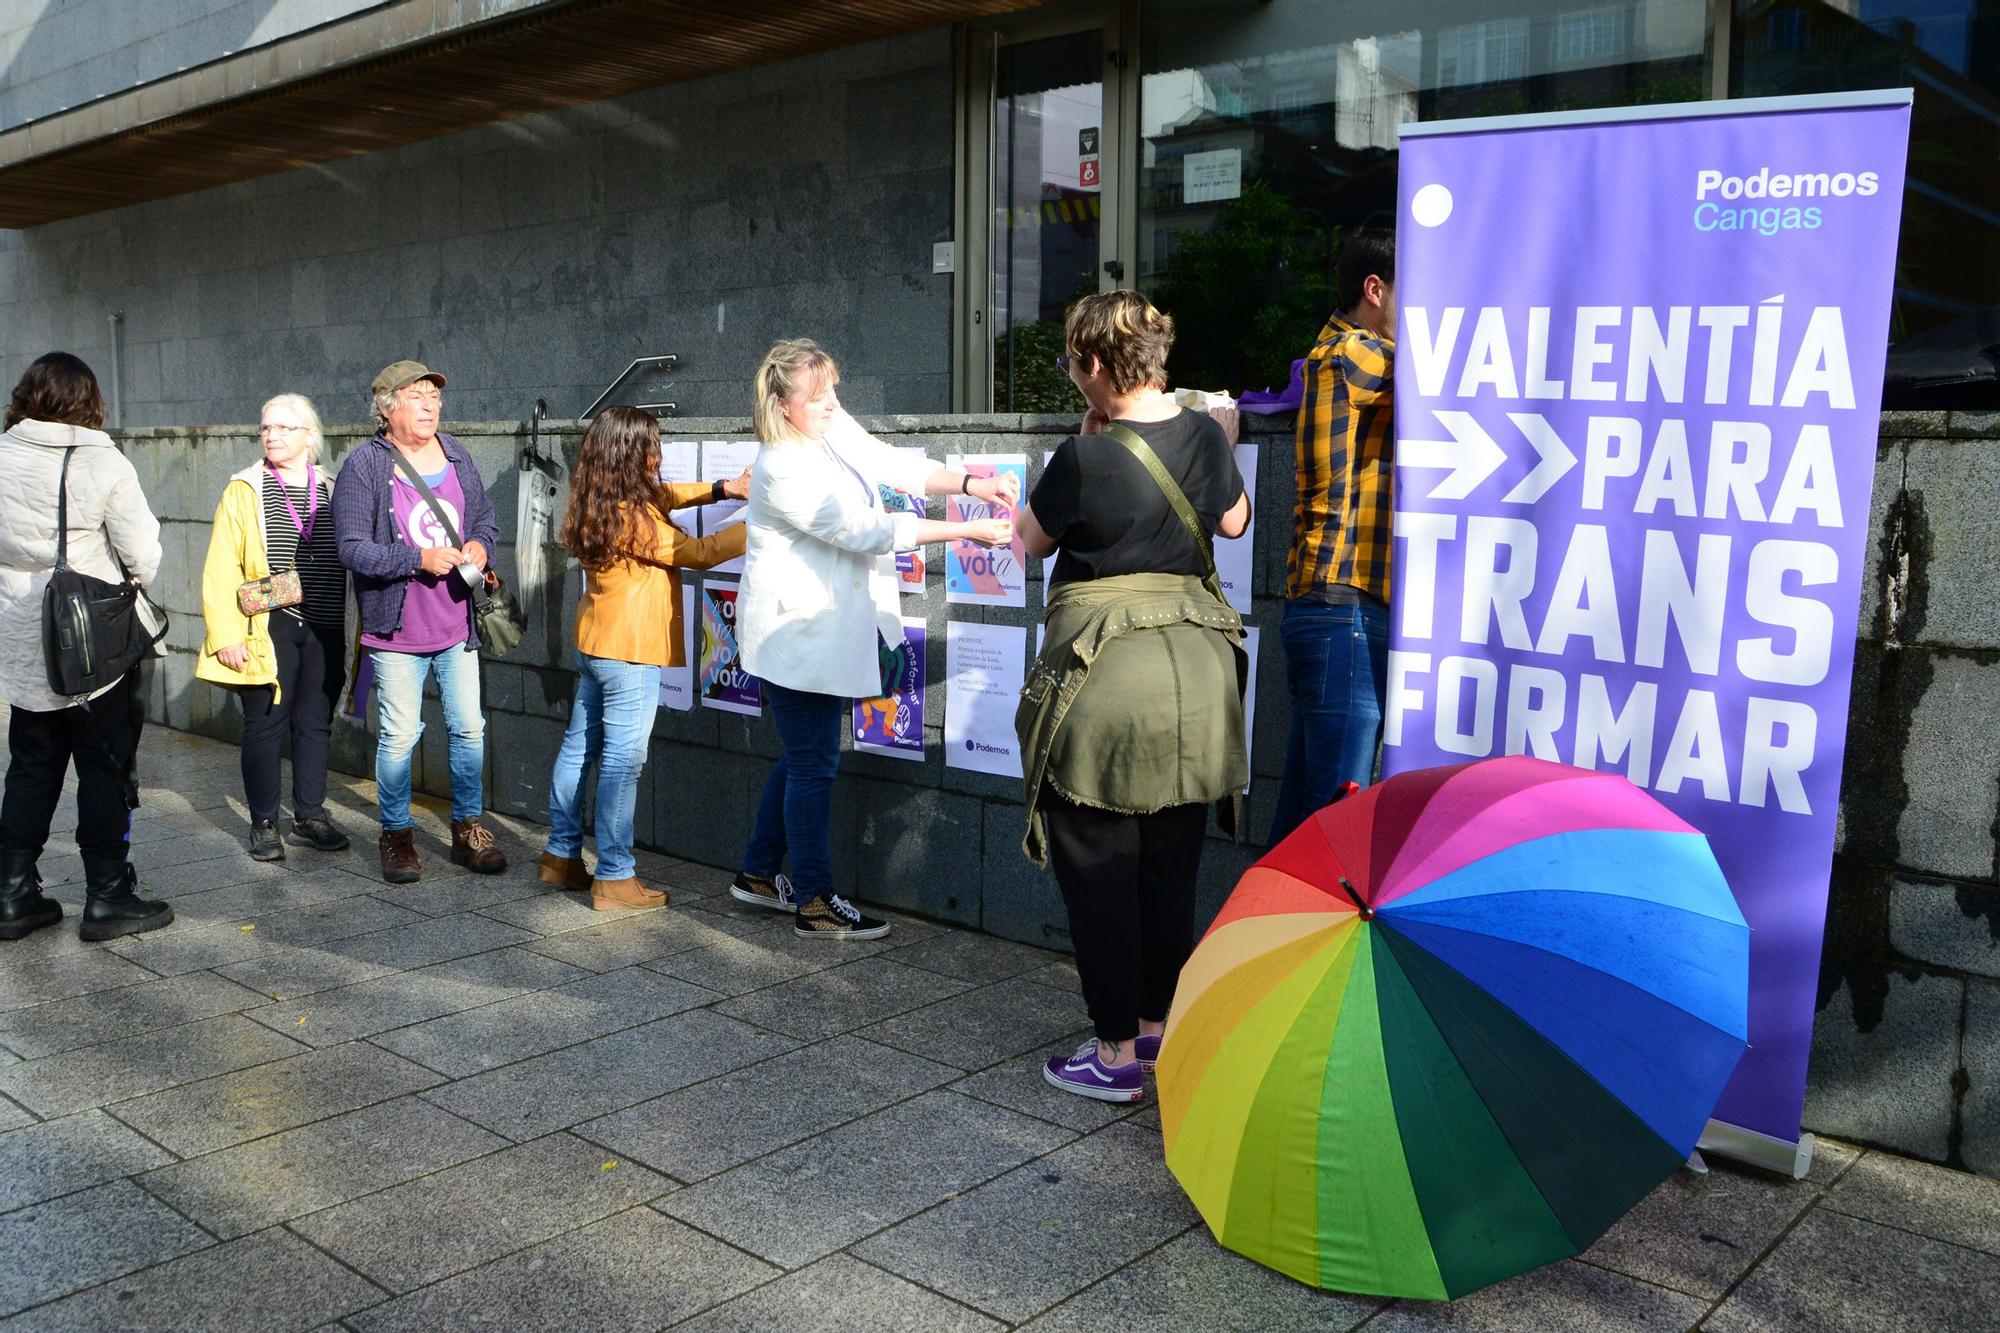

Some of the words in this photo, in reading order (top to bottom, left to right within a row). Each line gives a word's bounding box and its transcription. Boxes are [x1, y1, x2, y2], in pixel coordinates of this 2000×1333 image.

[1696, 167, 1879, 200] Podemos
[1693, 202, 1823, 236] Cangas
[1403, 293, 1857, 410] VALENTÍA
[1152, 463, 1179, 501] COLLECTION
[1581, 416, 1845, 528] PARA
[958, 551, 1012, 578] vota
[998, 583, 1022, 591] Podemos
[1393, 511, 1840, 687] TRANS
[708, 666, 751, 690] vota
[894, 735, 920, 747] Podemos
[975, 742, 1010, 755] Podemos
[1383, 649, 1818, 816] FORMAR
